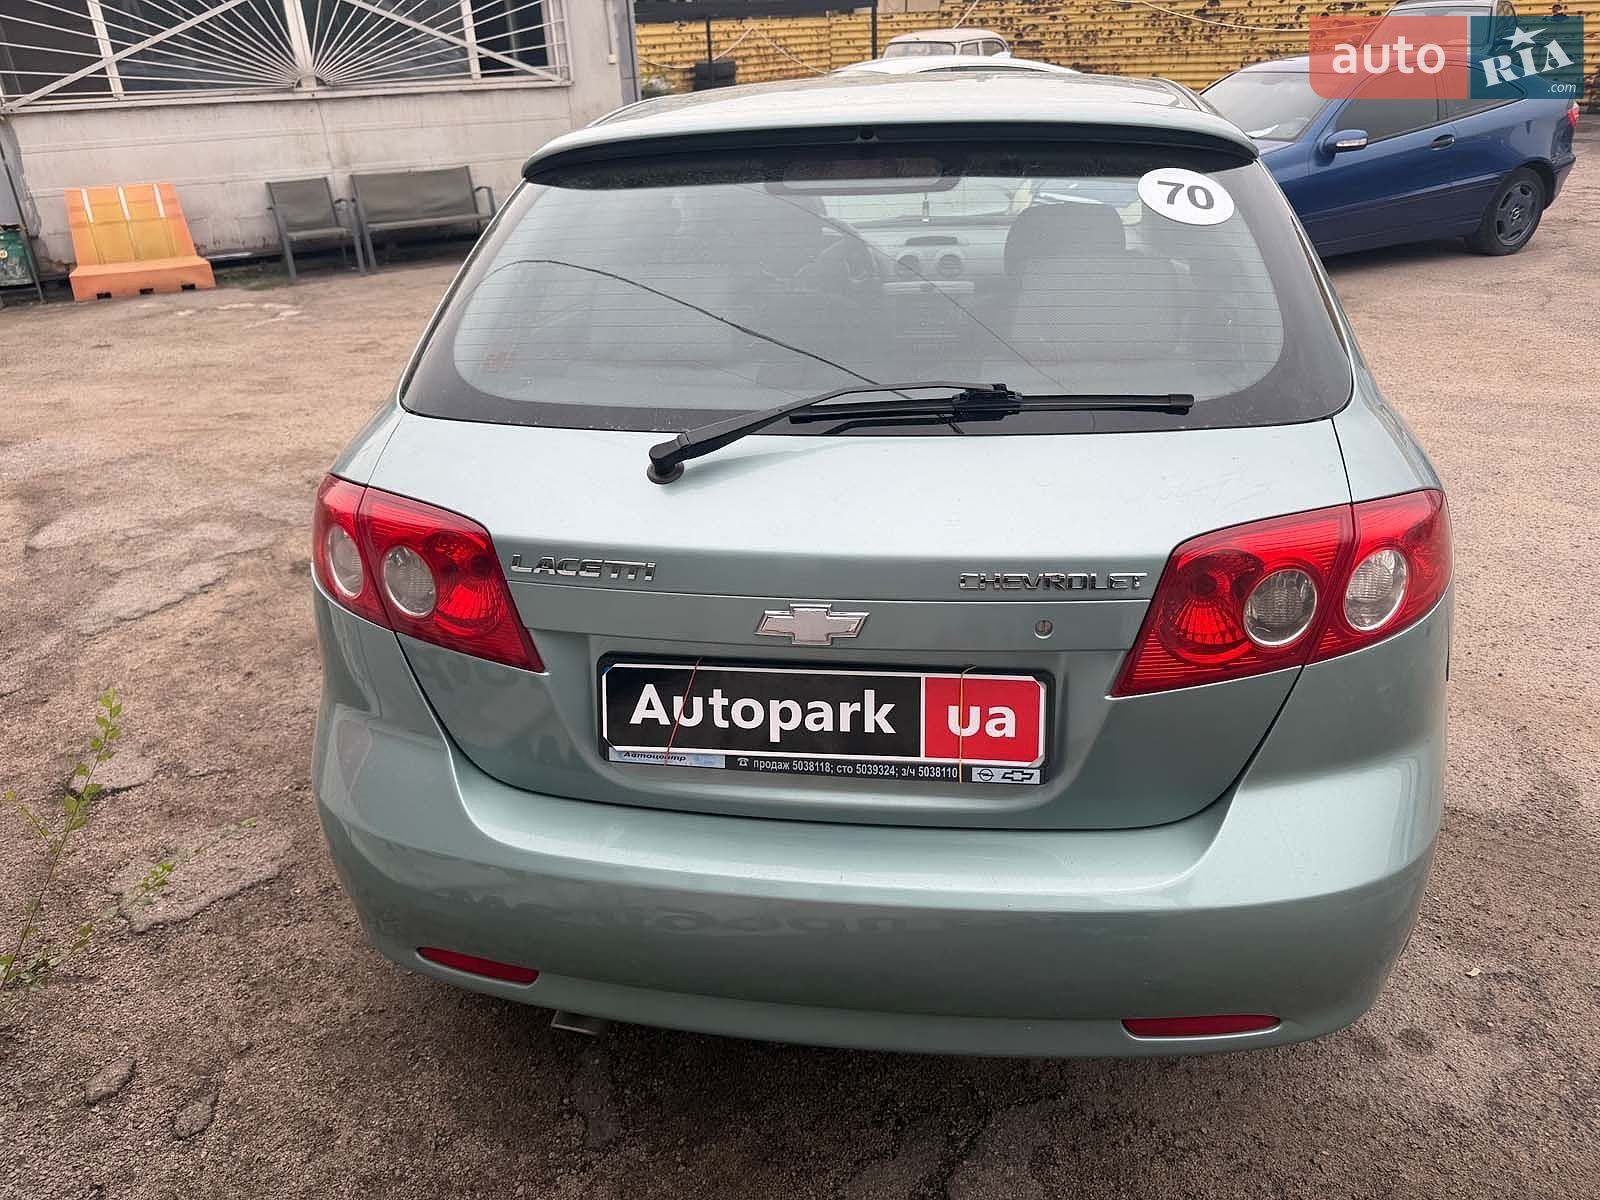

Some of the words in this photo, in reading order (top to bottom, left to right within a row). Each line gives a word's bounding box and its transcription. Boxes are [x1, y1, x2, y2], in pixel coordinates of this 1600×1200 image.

[1157, 180, 1215, 210] 70
[510, 554, 656, 581] LACETTI
[959, 573, 1148, 591] CHEVROLET
[629, 683, 897, 743] Autopark
[947, 705, 1017, 738] ua
[753, 759, 790, 771] продаж
[792, 760, 834, 774] 5038118;
[836, 764, 854, 774] сто
[856, 763, 899, 778] 5039324;
[918, 766, 958, 778] 5038110
